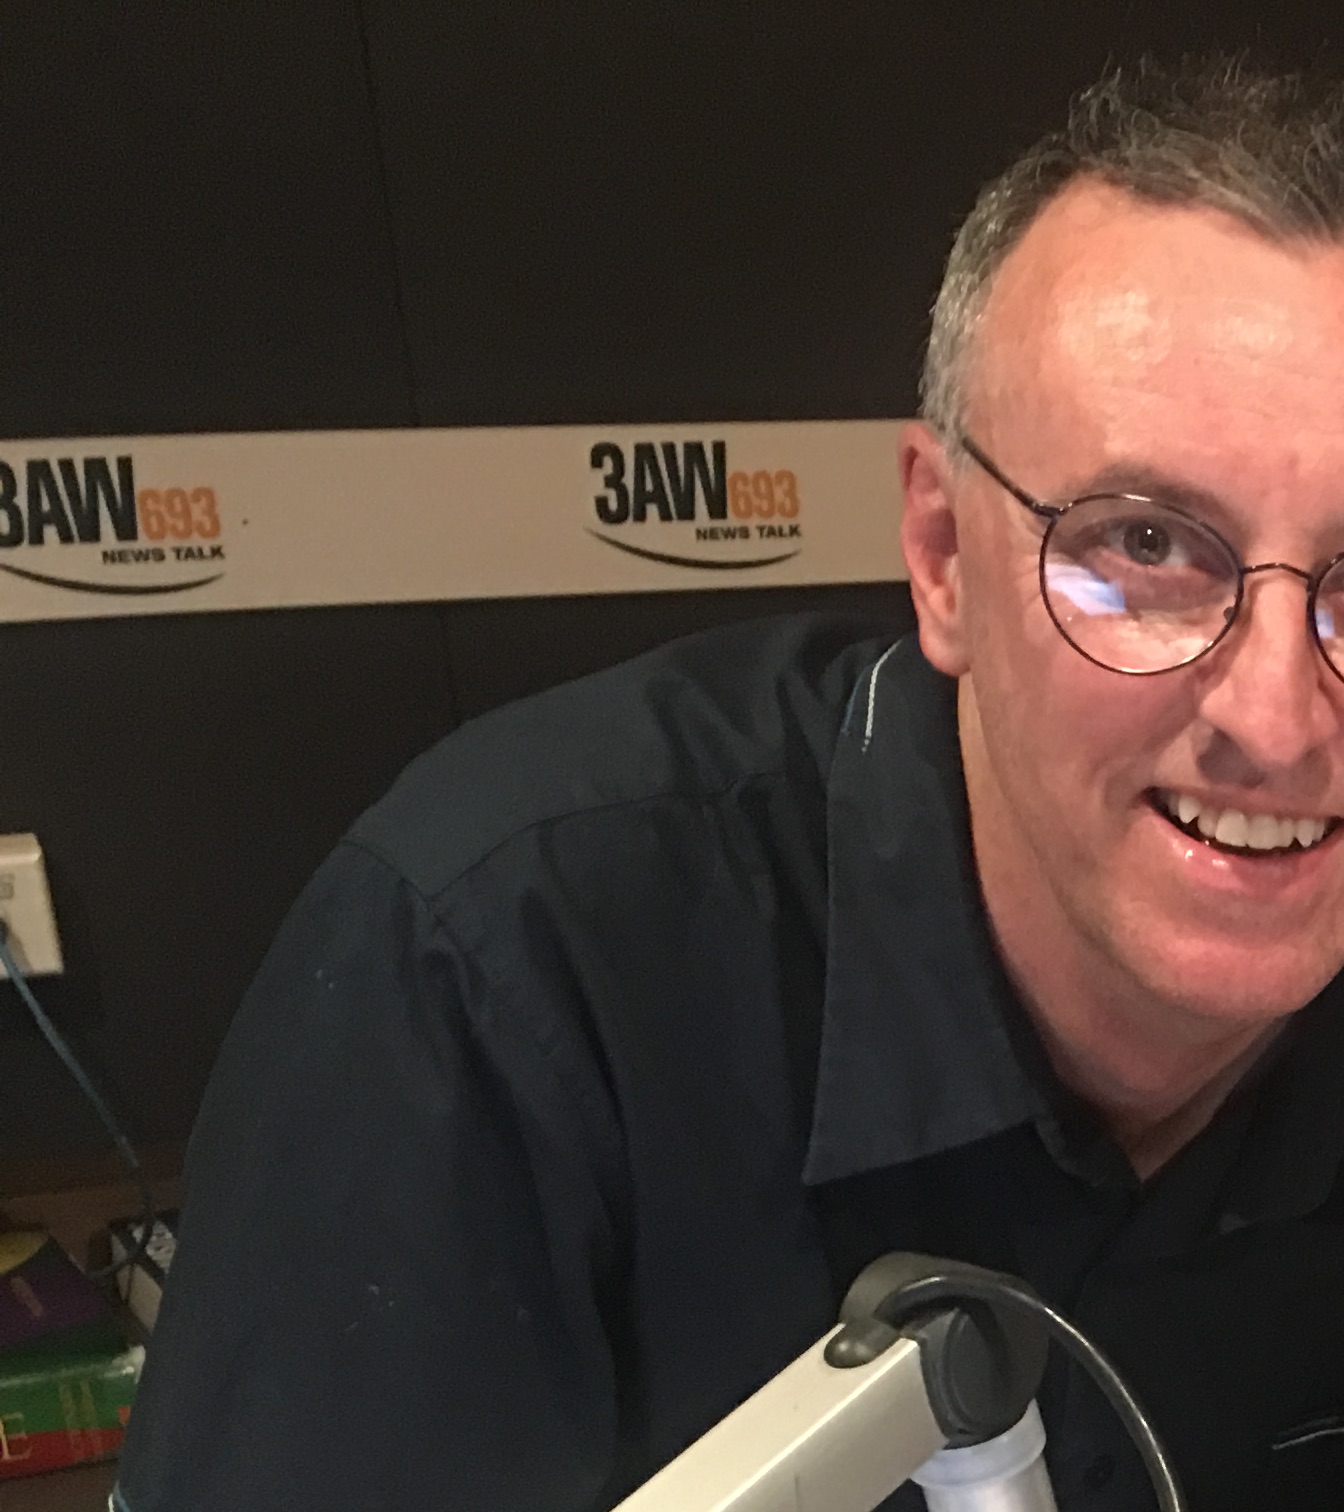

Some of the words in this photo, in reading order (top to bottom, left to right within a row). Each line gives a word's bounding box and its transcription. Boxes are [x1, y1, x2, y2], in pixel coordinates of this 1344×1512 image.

[695, 527, 750, 541] NEWS
[755, 524, 802, 539] TALK
[101, 549, 166, 565] NEWS
[171, 545, 226, 562] TALK
